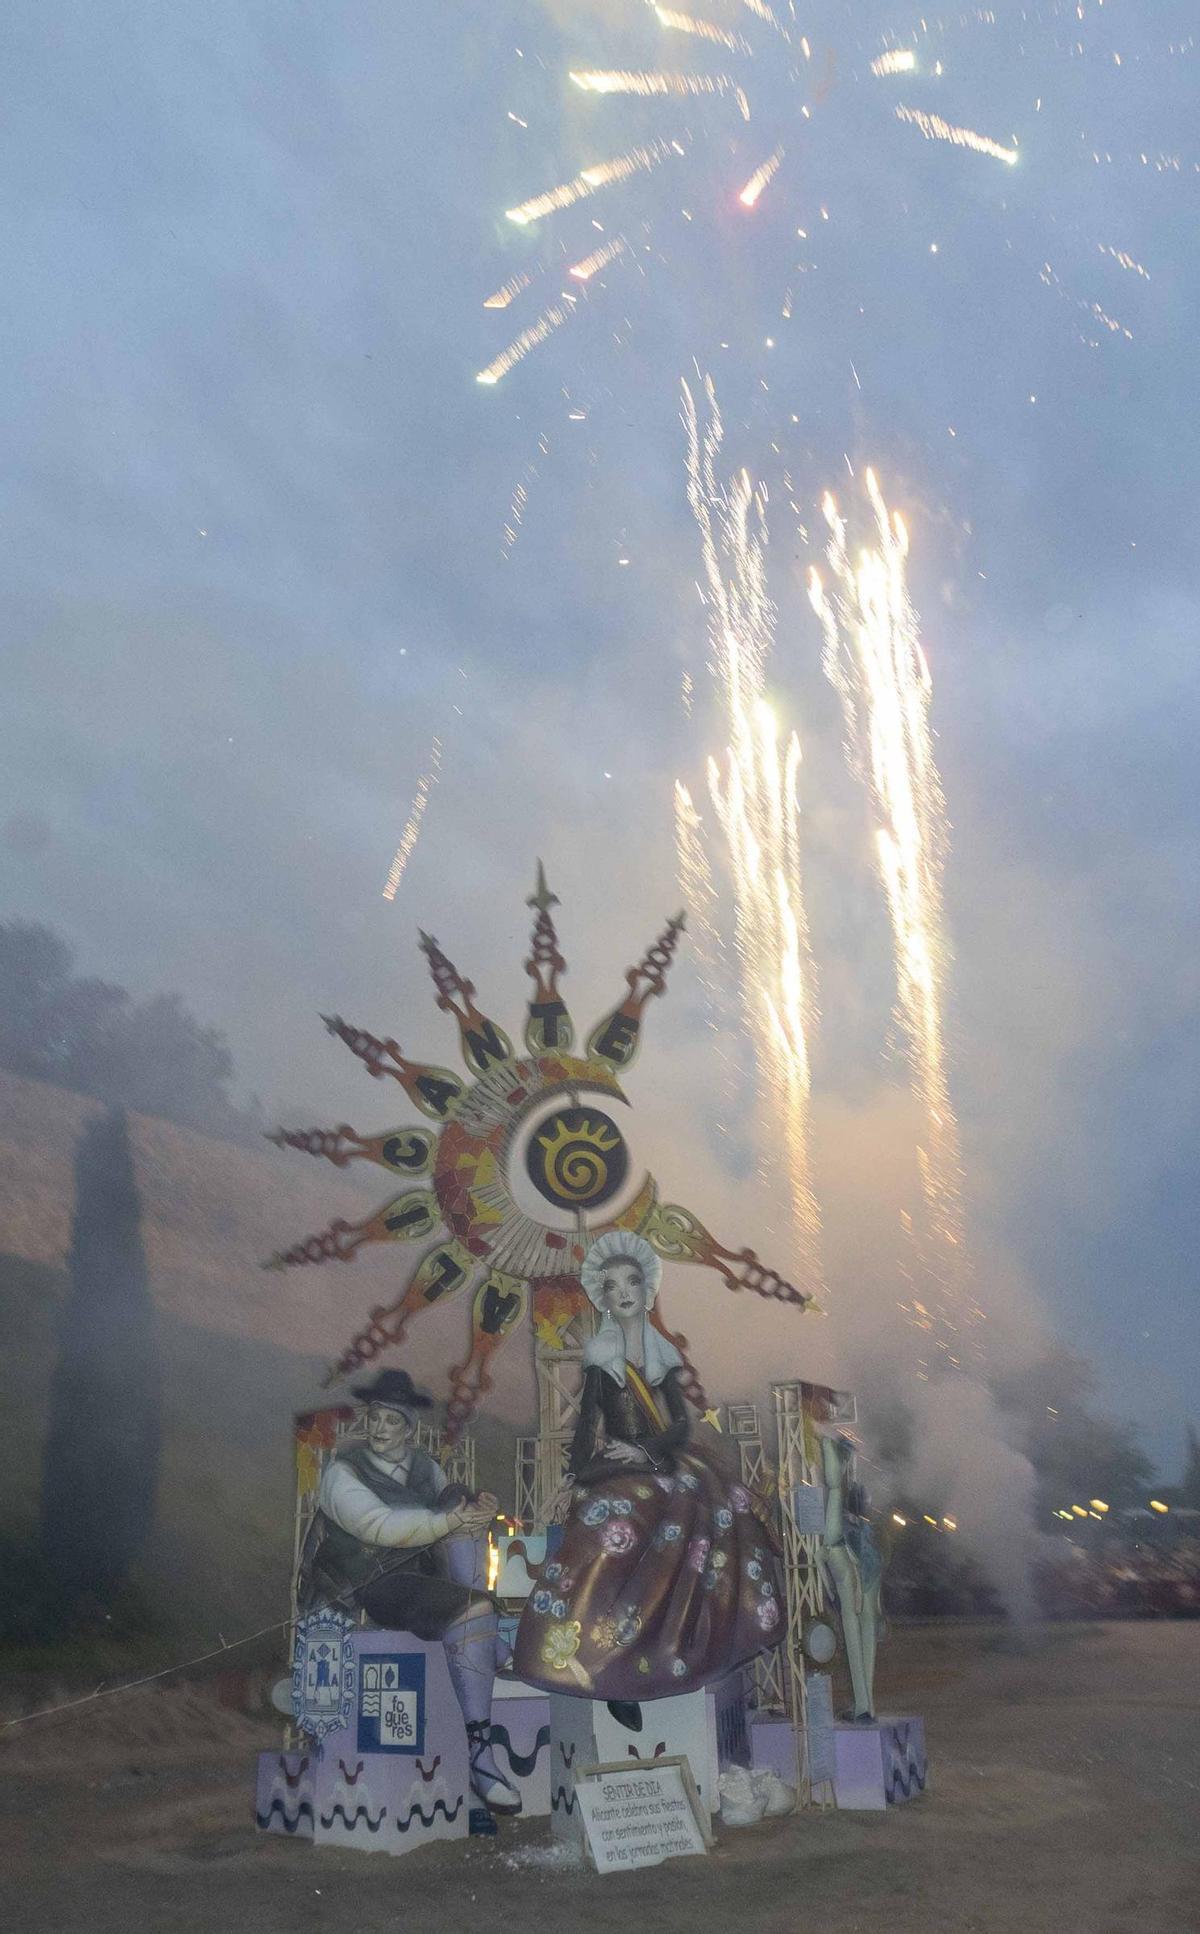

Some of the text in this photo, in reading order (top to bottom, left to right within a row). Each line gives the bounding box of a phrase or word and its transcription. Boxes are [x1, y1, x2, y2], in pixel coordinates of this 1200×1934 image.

[602, 1784, 633, 1800] SENTIR
[633, 1782, 646, 1797] DE
[592, 1806, 621, 1822] Alicante
[621, 1803, 649, 1818] celebra
[648, 1803, 661, 1814] sus
[601, 1830, 615, 1842] con
[615, 1823, 658, 1840] sentimiento
